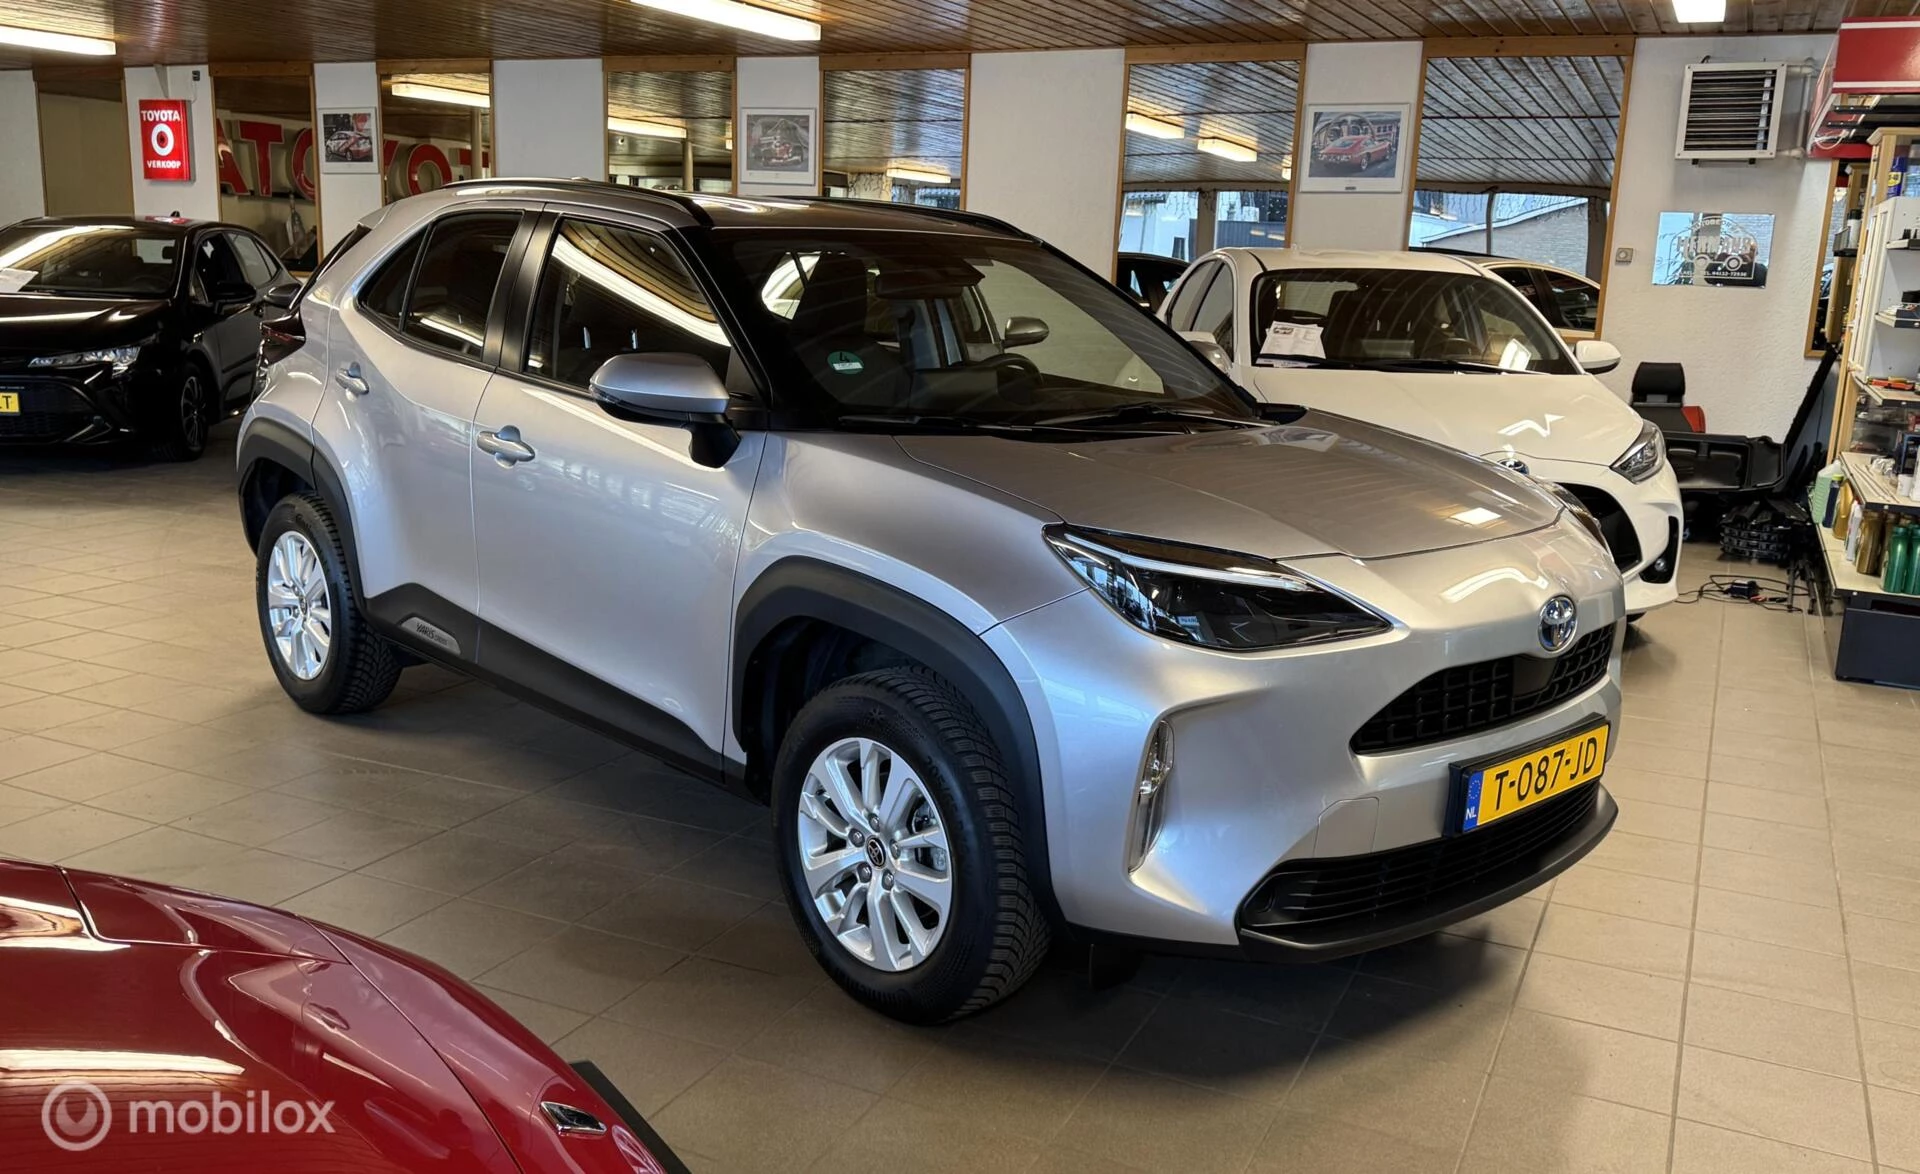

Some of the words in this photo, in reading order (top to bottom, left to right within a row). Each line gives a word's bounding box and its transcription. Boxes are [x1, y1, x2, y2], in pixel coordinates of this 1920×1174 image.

[141, 109, 180, 121] TOYOTA
[147, 160, 181, 168] VERKOOP
[0, 395, 12, 409] T
[1495, 737, 1597, 811] T-087-JD
[1465, 806, 1477, 820] NL
